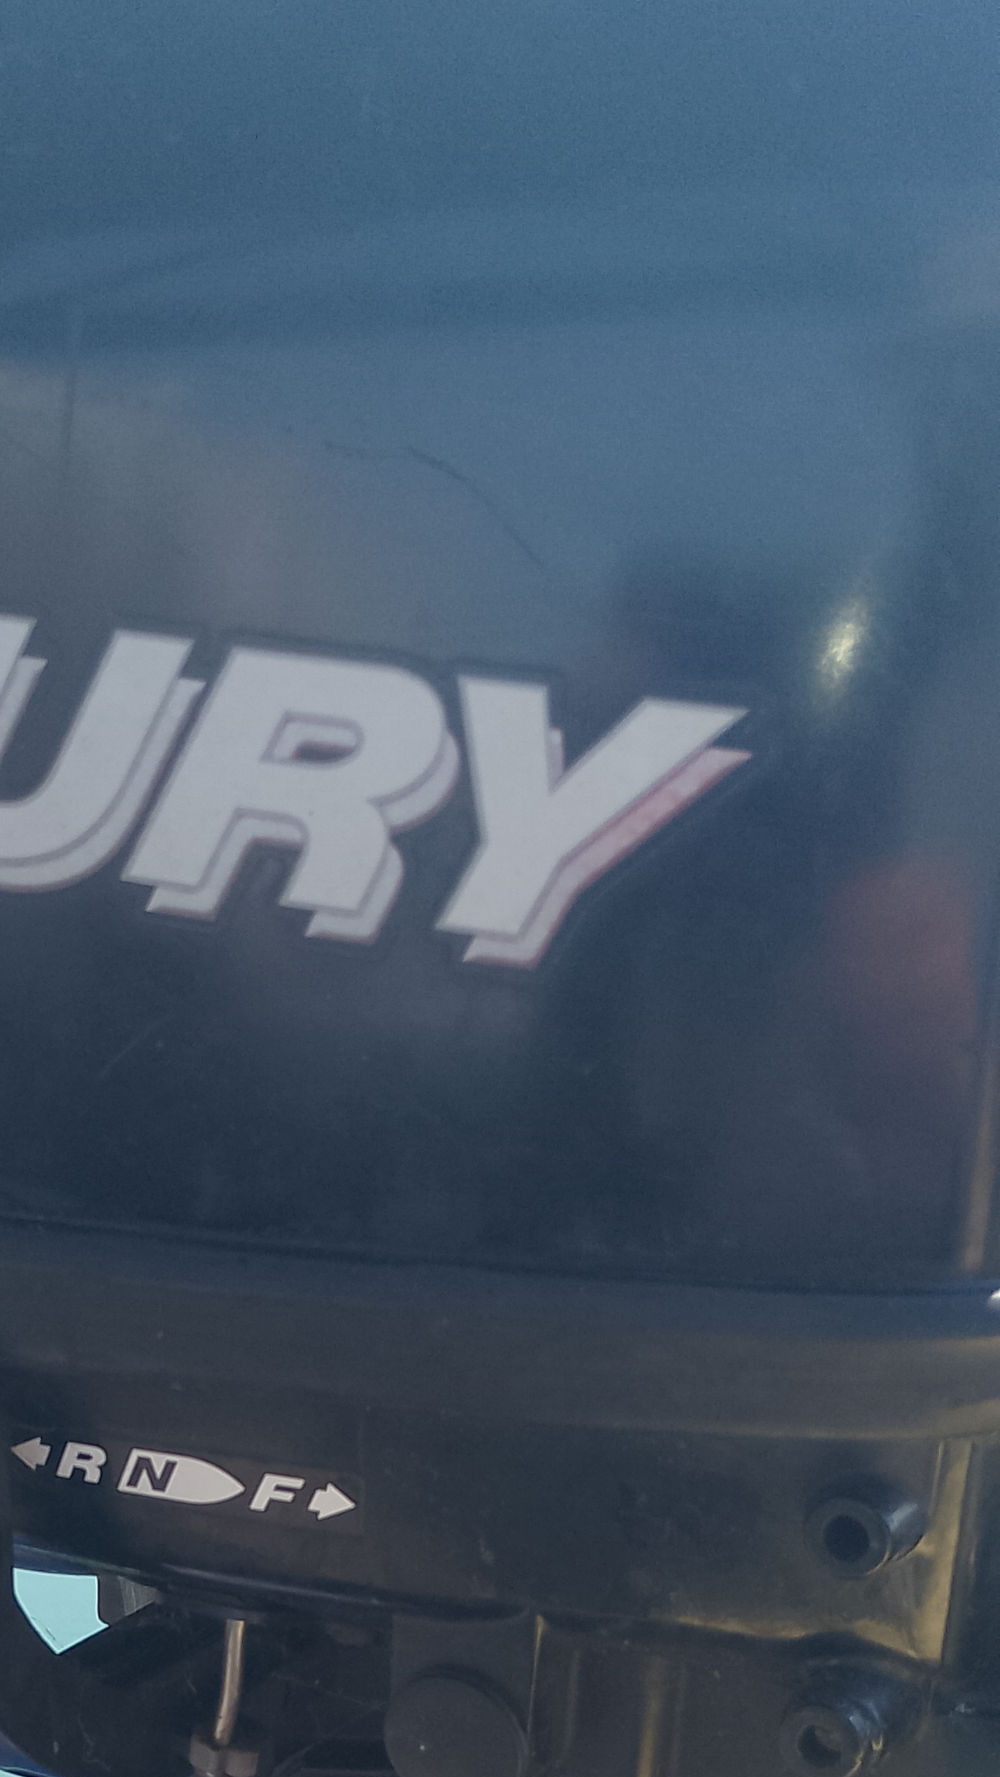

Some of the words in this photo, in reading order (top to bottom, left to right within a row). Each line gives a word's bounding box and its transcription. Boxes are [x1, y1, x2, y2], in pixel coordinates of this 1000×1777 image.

[56, 1441, 107, 1484] R
[126, 1456, 178, 1493] N
[248, 1472, 305, 1512] F
